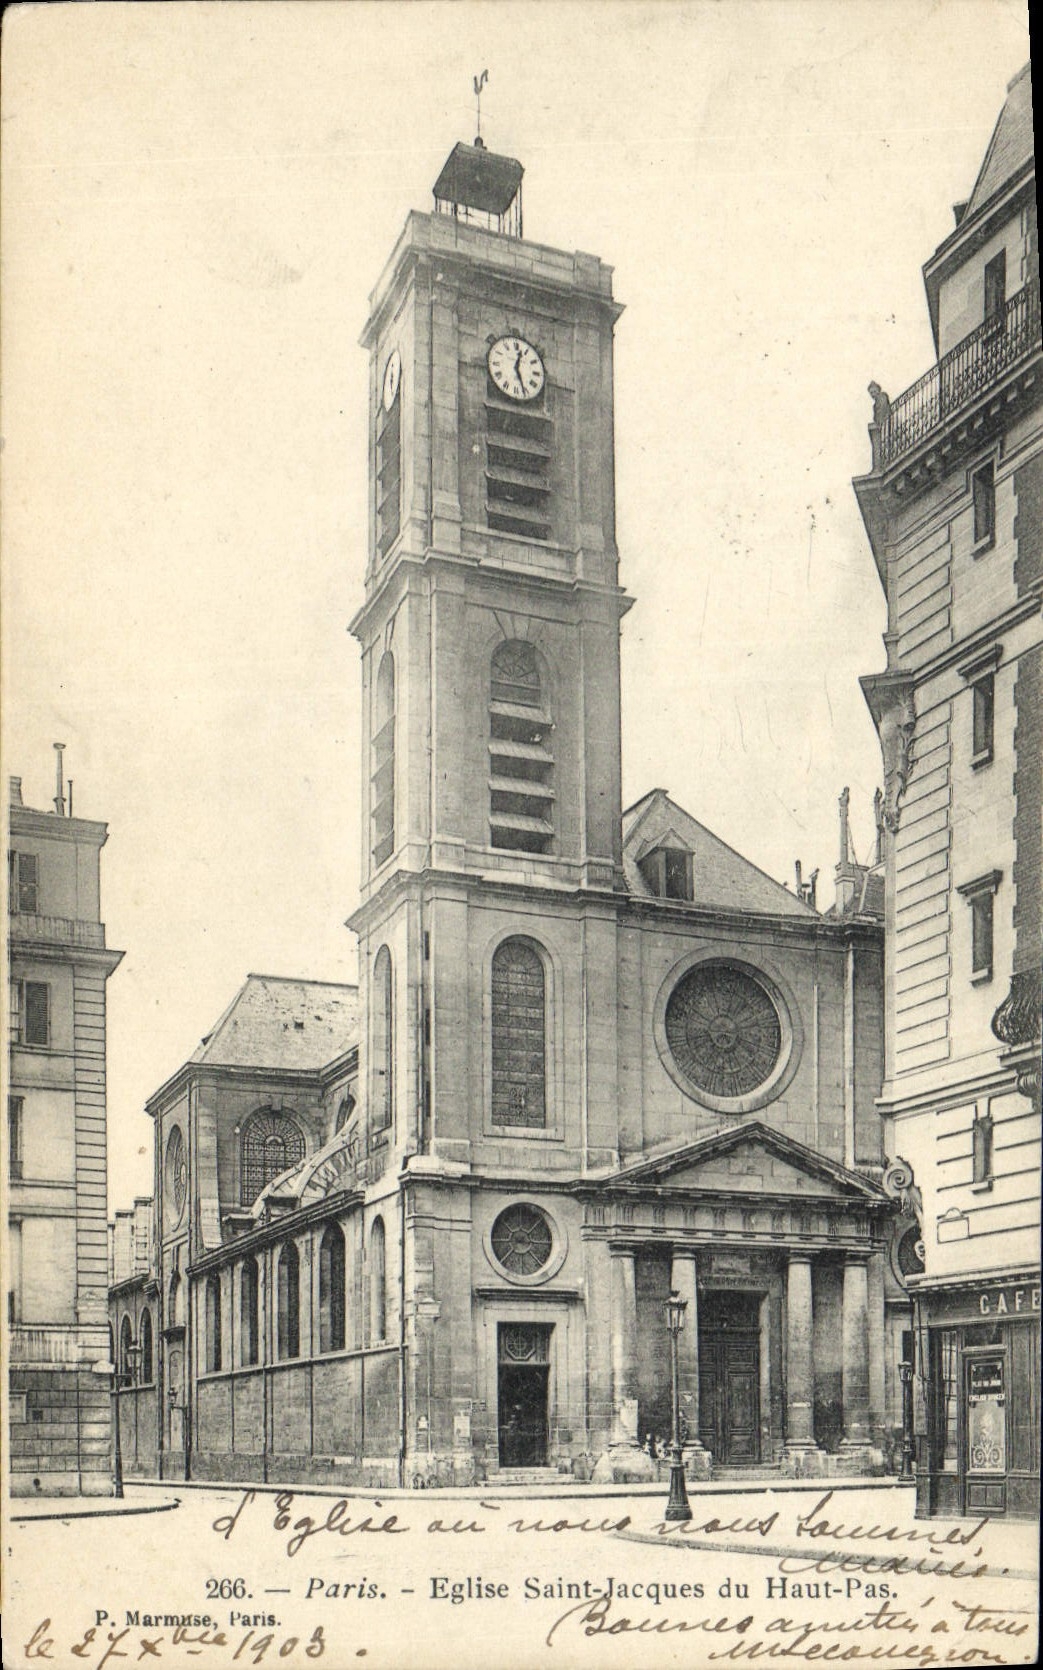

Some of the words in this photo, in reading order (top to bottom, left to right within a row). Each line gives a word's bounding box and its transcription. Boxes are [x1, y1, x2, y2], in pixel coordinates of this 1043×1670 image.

[507, 1516, 631, 1533] nous
[651, 1512, 780, 1536] nous
[24, 1618, 54, 1658] le
